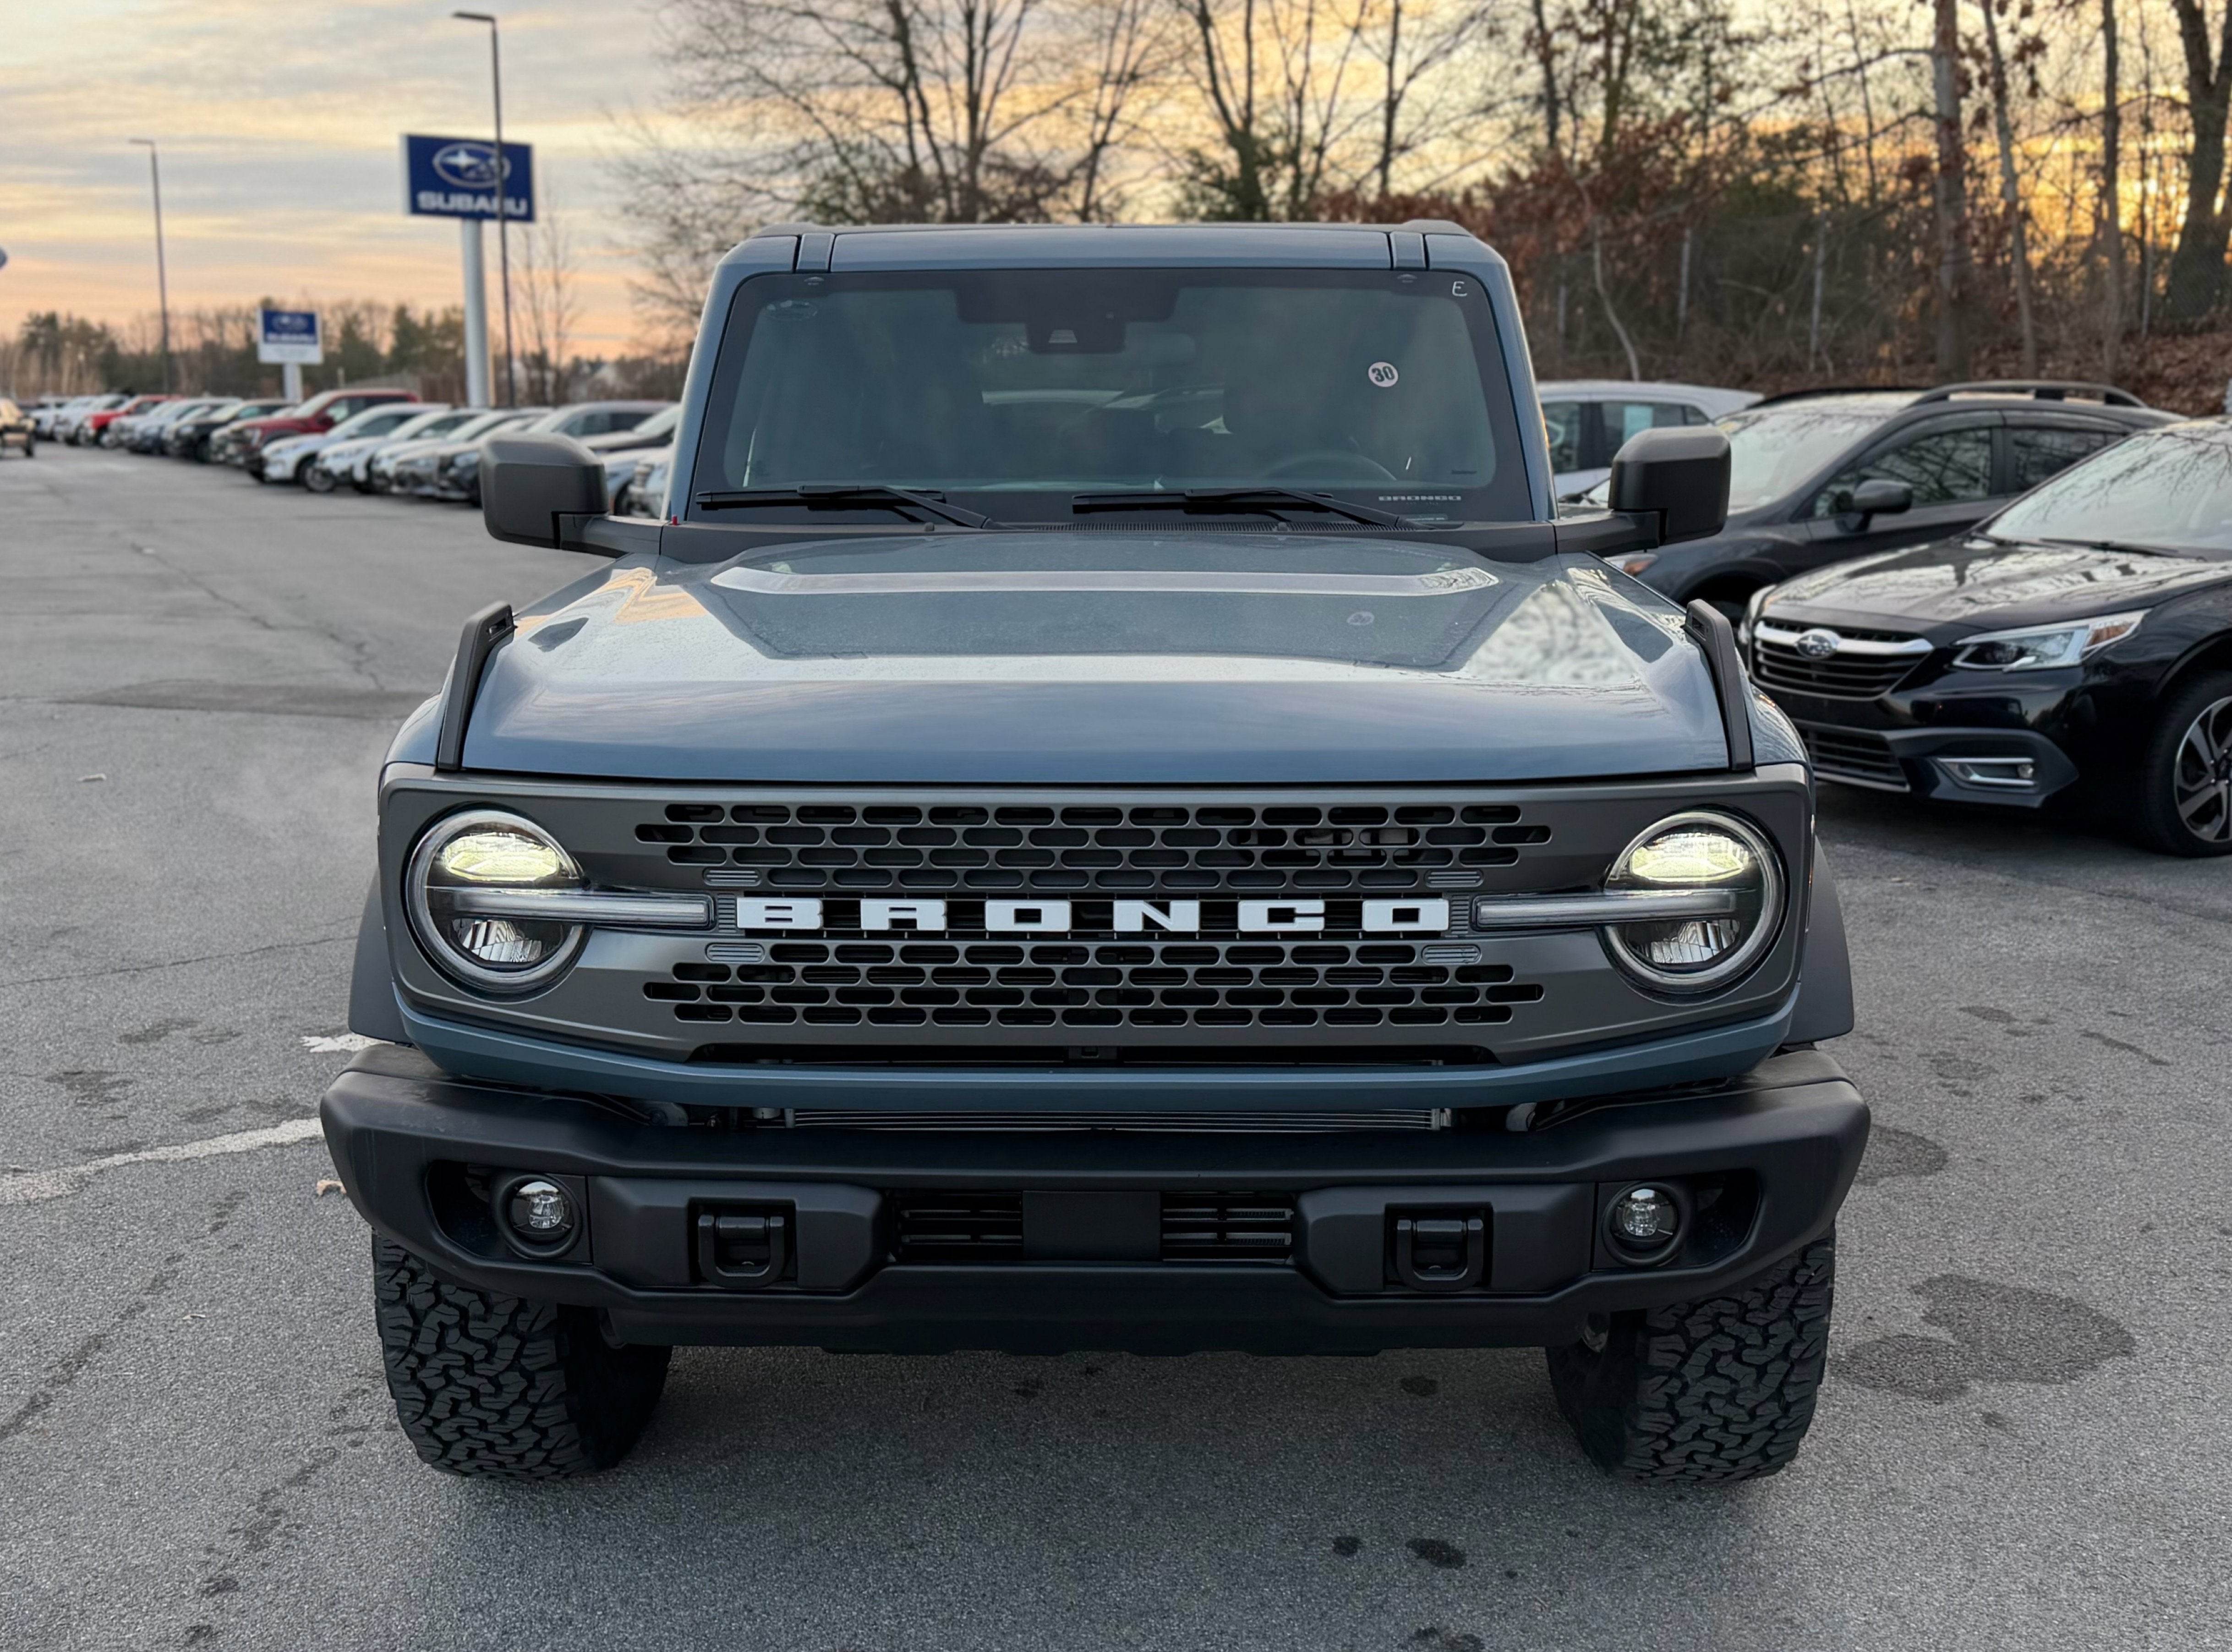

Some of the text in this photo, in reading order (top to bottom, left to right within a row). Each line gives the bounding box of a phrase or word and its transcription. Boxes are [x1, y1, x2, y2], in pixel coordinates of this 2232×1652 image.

[1452, 281, 1467, 297] E
[1372, 365, 1395, 382] 30
[737, 897, 1449, 932] BRONCO
